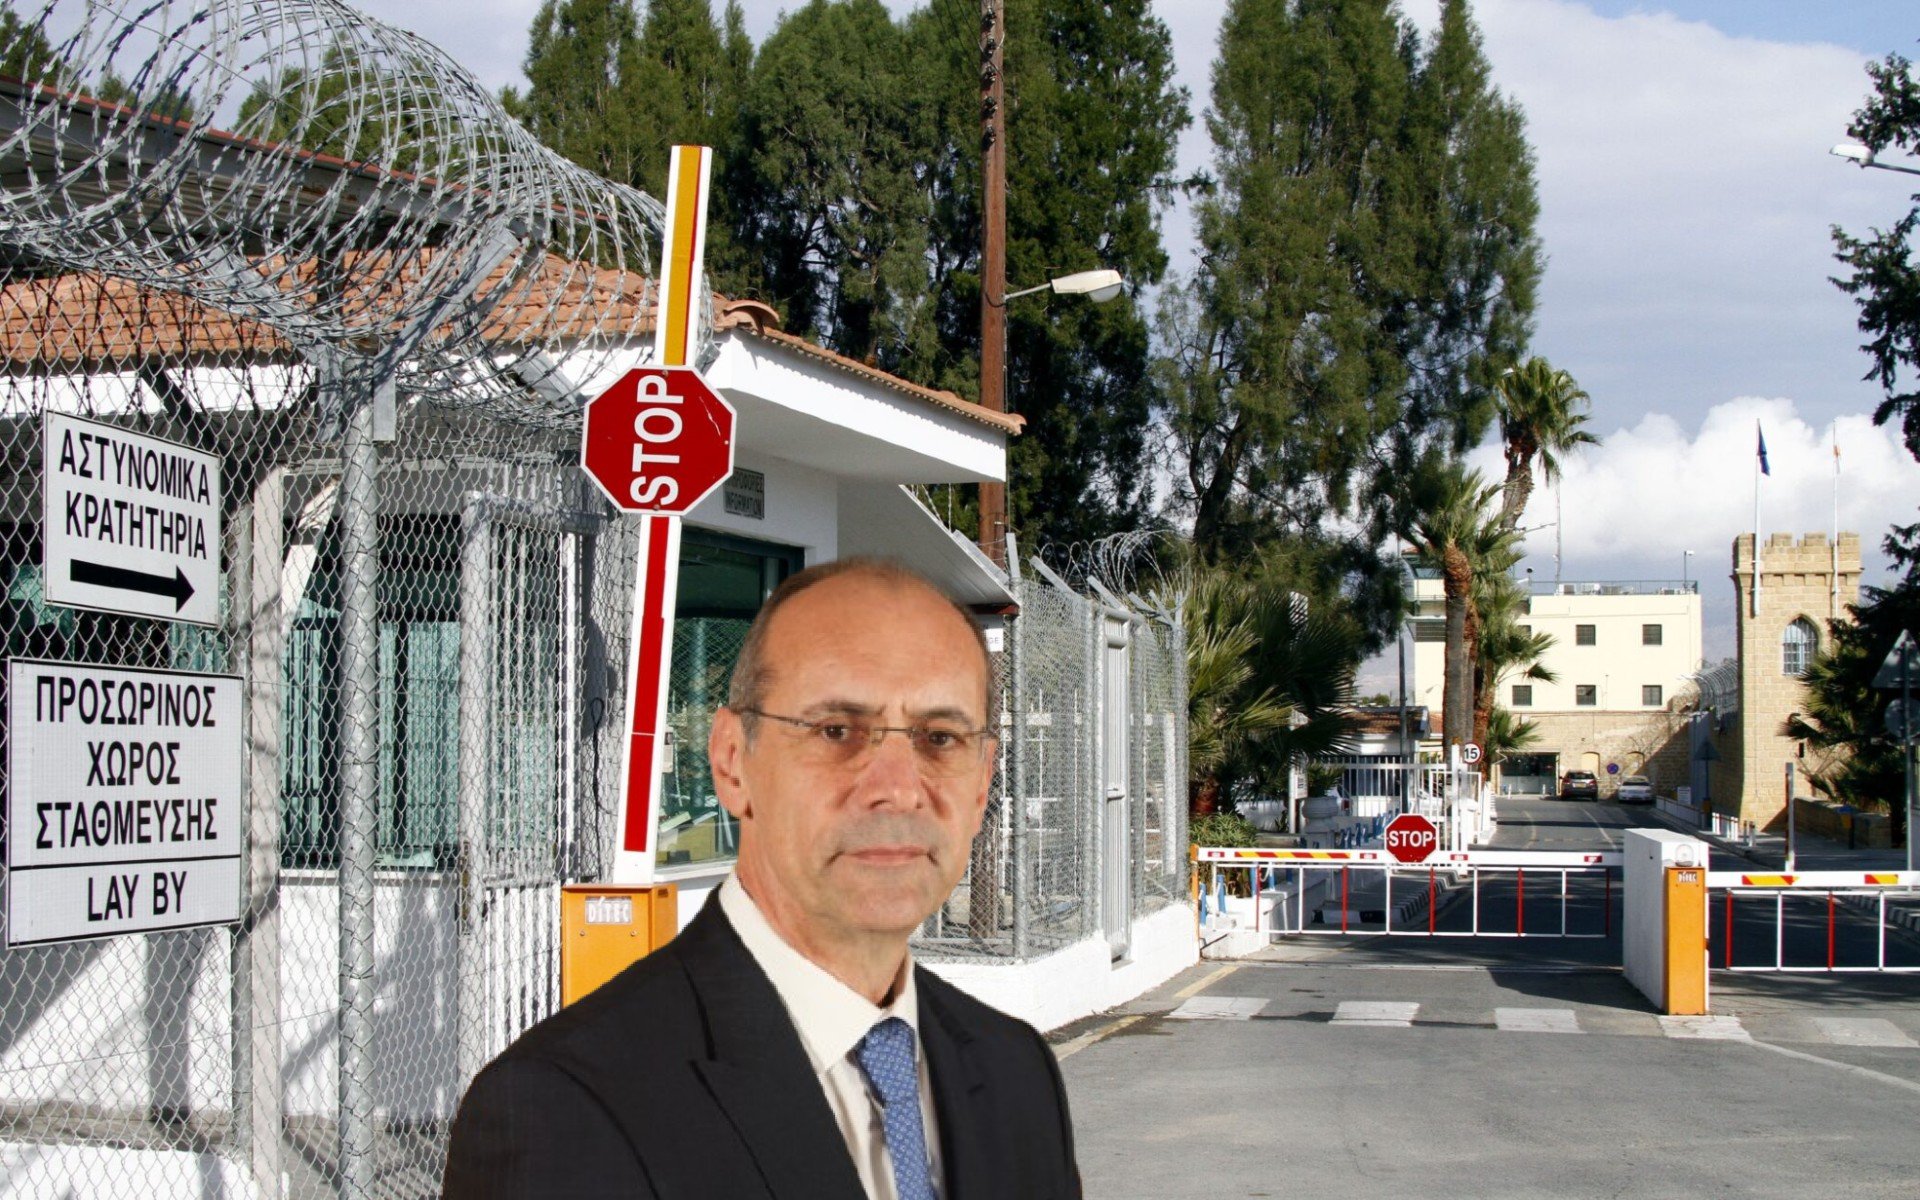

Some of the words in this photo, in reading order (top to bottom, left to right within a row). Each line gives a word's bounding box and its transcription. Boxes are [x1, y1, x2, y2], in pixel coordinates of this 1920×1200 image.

[630, 374, 684, 506] STOP
[59, 429, 210, 506] ΑΣΤΥΝΟΜΙΚΑ
[66, 490, 207, 560] ΚΡΑΤΗΤΗΡΙΑ
[36, 675, 216, 727] ΠΡΟΣΩΡΙΝΟΣ
[86, 741, 180, 786] ΧΩΡΟΣ
[1464, 747, 1478, 760] 15
[36, 798, 217, 849] ΣΤΑΘΜΕΥΣΗΣ
[1388, 830, 1433, 847] STOP
[88, 874, 139, 922] LAY
[153, 871, 187, 915] BY
